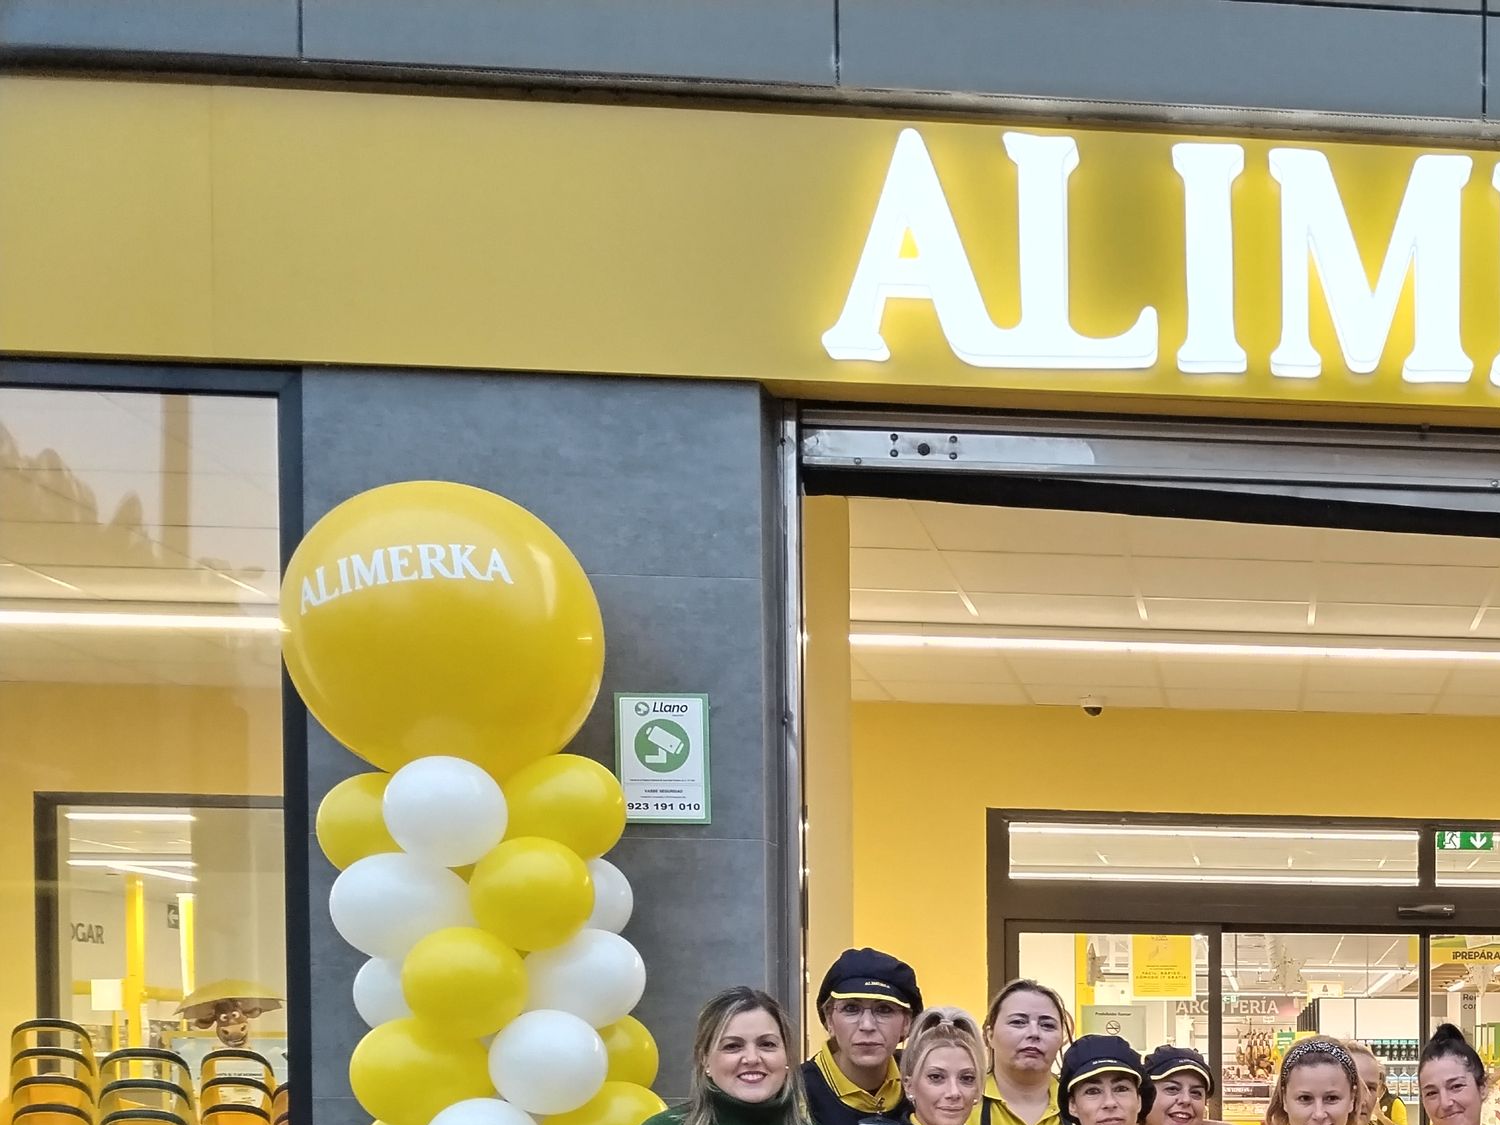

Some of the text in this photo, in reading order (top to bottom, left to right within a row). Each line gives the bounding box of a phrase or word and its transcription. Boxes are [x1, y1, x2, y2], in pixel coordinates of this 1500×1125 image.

[301, 544, 514, 616] ALIMERKA
[652, 702, 688, 713] Llano
[654, 803, 674, 811] 191
[679, 803, 701, 811] 010
